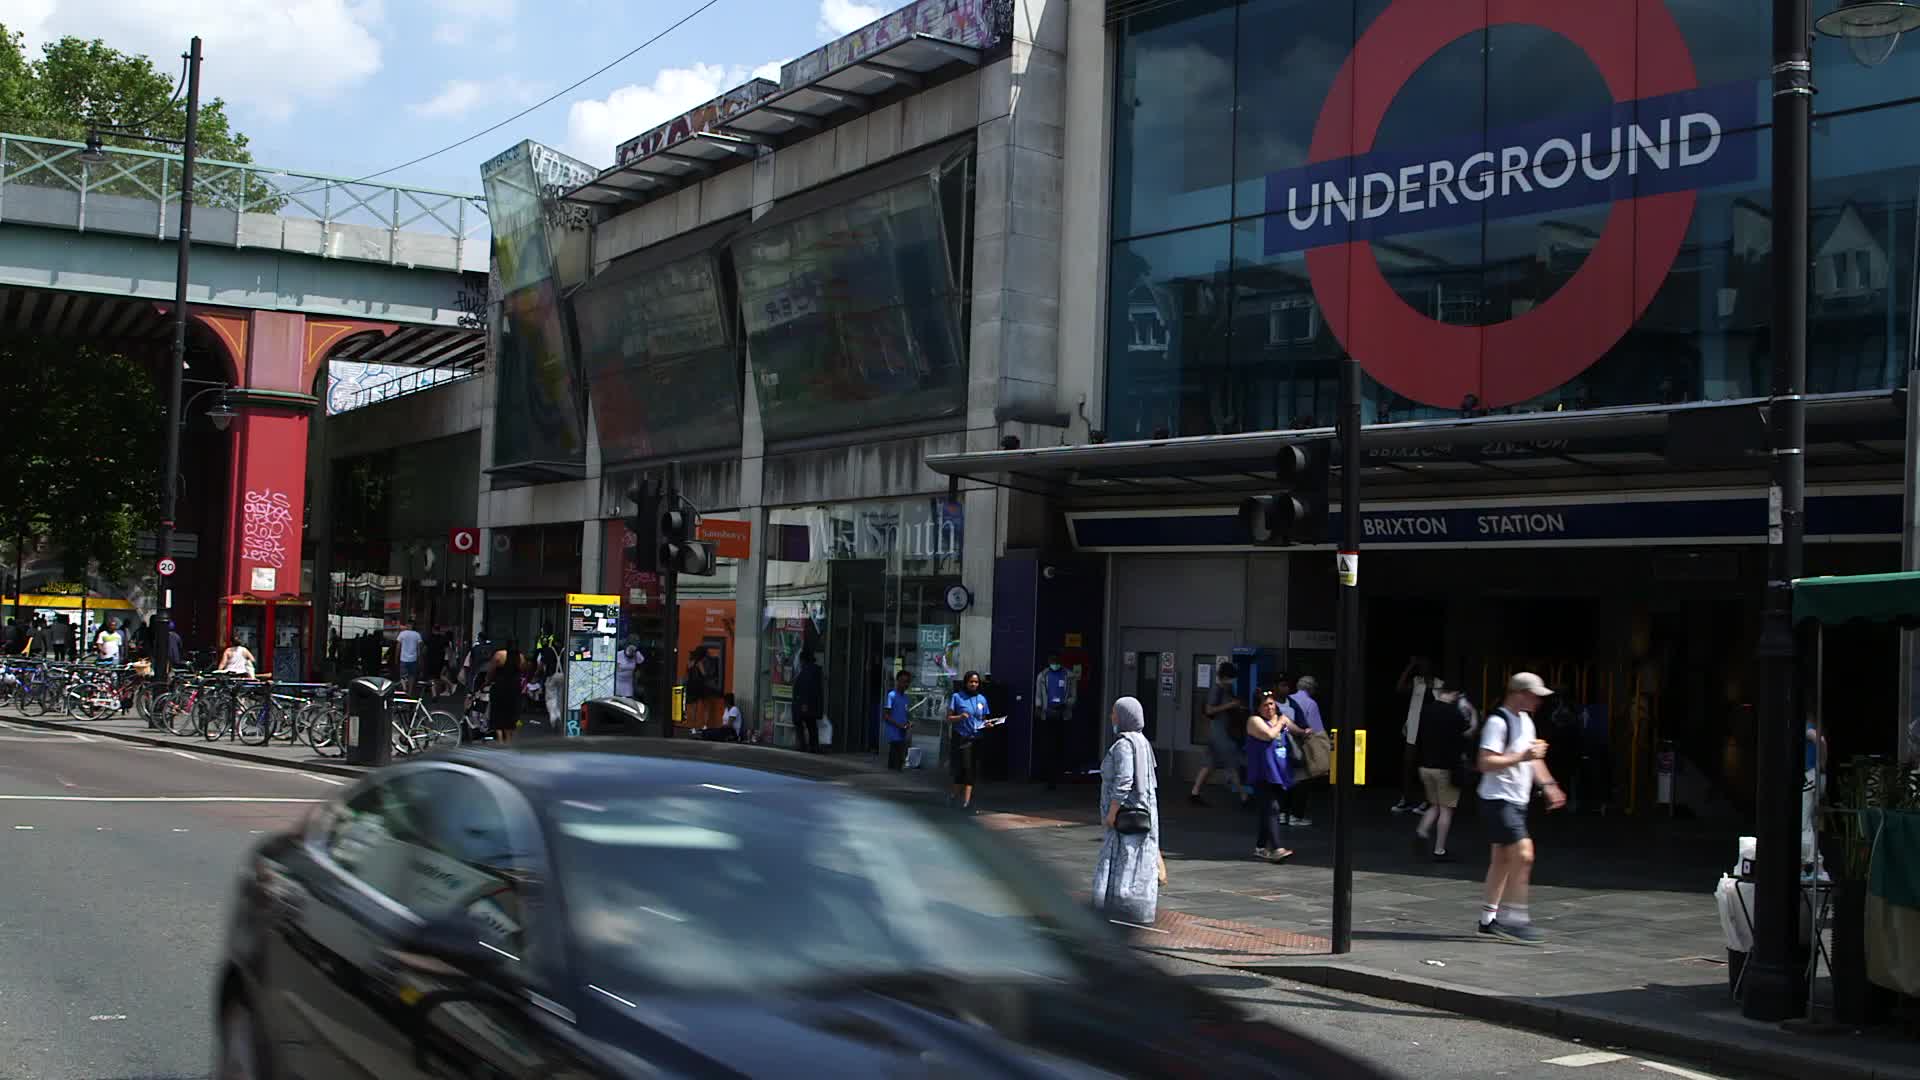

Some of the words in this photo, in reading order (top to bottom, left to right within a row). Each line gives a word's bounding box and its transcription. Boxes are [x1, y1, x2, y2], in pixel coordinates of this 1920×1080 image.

[1287, 112, 1721, 231] UNDERGROUND
[1363, 517, 1448, 536] BRIXTON
[1477, 514, 1566, 534] STATION
[161, 563, 174, 571] 20
